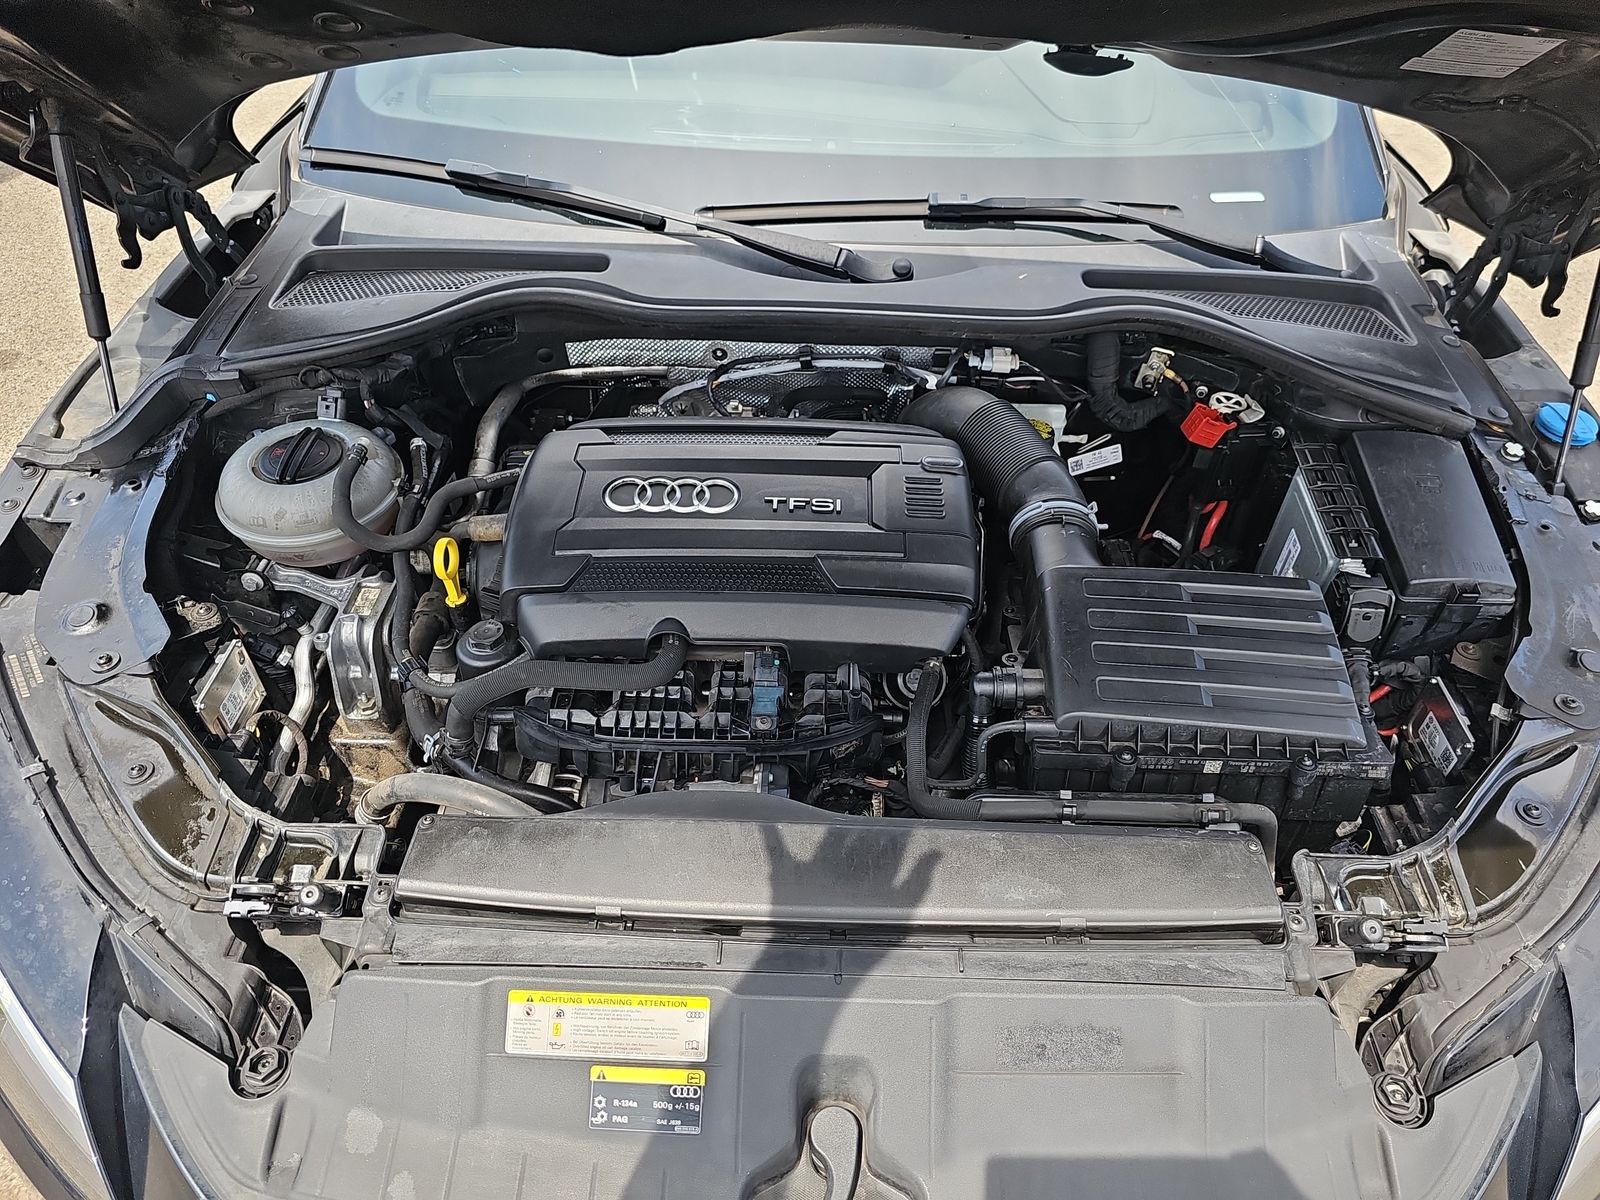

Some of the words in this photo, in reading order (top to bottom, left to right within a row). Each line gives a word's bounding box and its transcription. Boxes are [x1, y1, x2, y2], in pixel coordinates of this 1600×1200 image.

[764, 496, 842, 514] TFSI
[538, 995, 583, 1004] ACHTUNG
[587, 997, 633, 1006] WARNING
[637, 1000, 688, 1008] ATTENTION
[613, 1099, 638, 1108] R-134a
[652, 1100, 673, 1110] 500g
[612, 1115, 629, 1124] PAG
